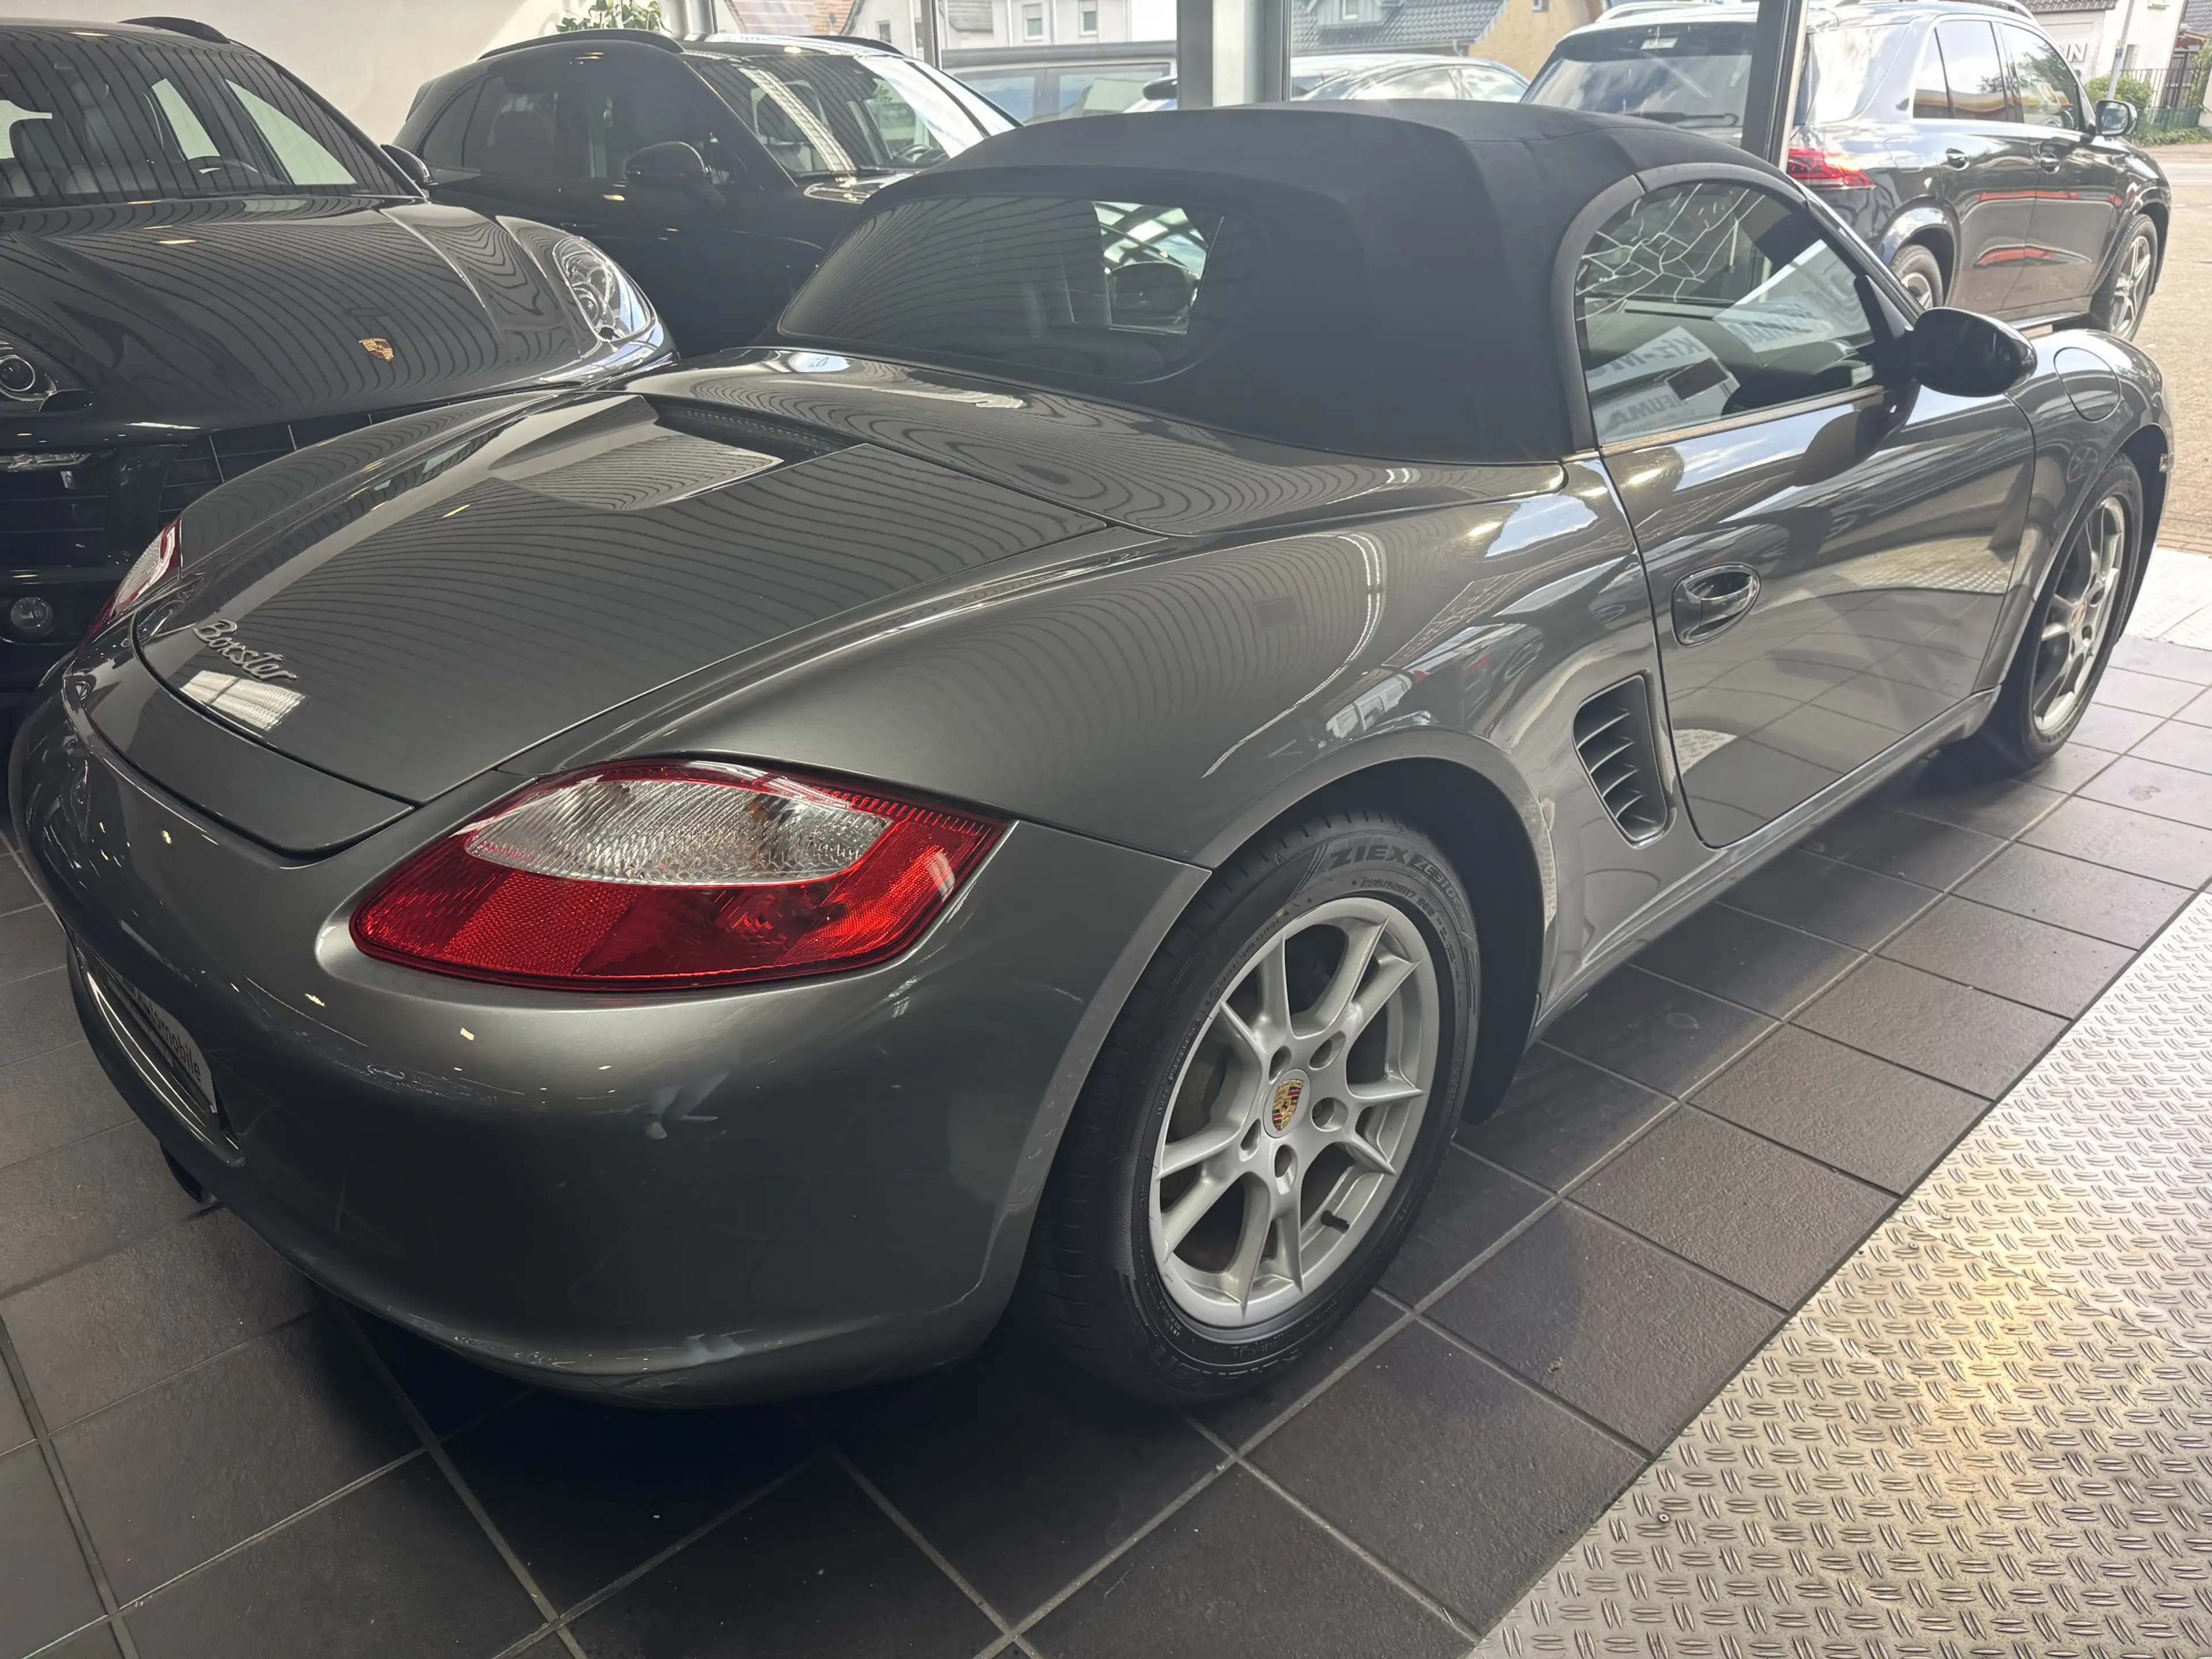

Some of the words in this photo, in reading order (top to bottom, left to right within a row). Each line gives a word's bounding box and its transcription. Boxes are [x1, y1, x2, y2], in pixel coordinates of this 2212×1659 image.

[193, 619, 298, 680] Boxster
[1328, 844, 1409, 871] ZIEX
[1414, 857, 1456, 898] ZE310
